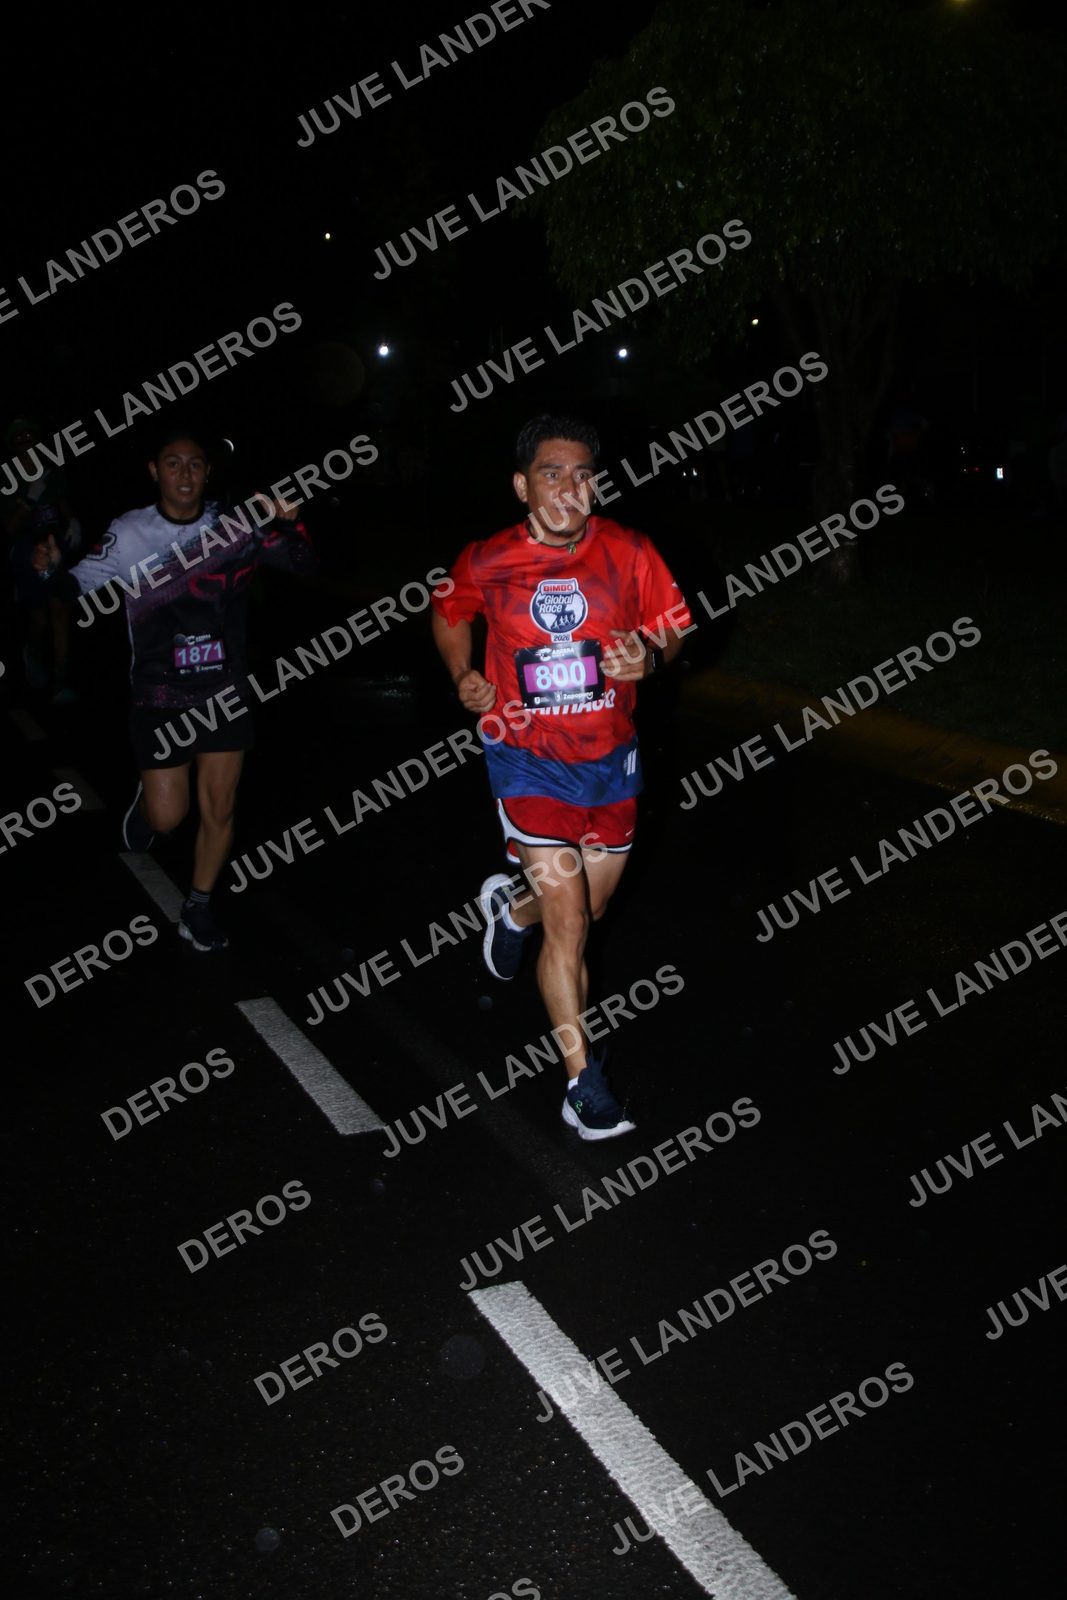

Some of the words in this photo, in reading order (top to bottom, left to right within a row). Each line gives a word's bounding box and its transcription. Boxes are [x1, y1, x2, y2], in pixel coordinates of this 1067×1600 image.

[543, 584, 574, 592] BIMBO
[544, 595, 573, 604] Global
[539, 604, 563, 613] Race
[177, 641, 222, 665] 1871
[535, 661, 587, 690] 800
